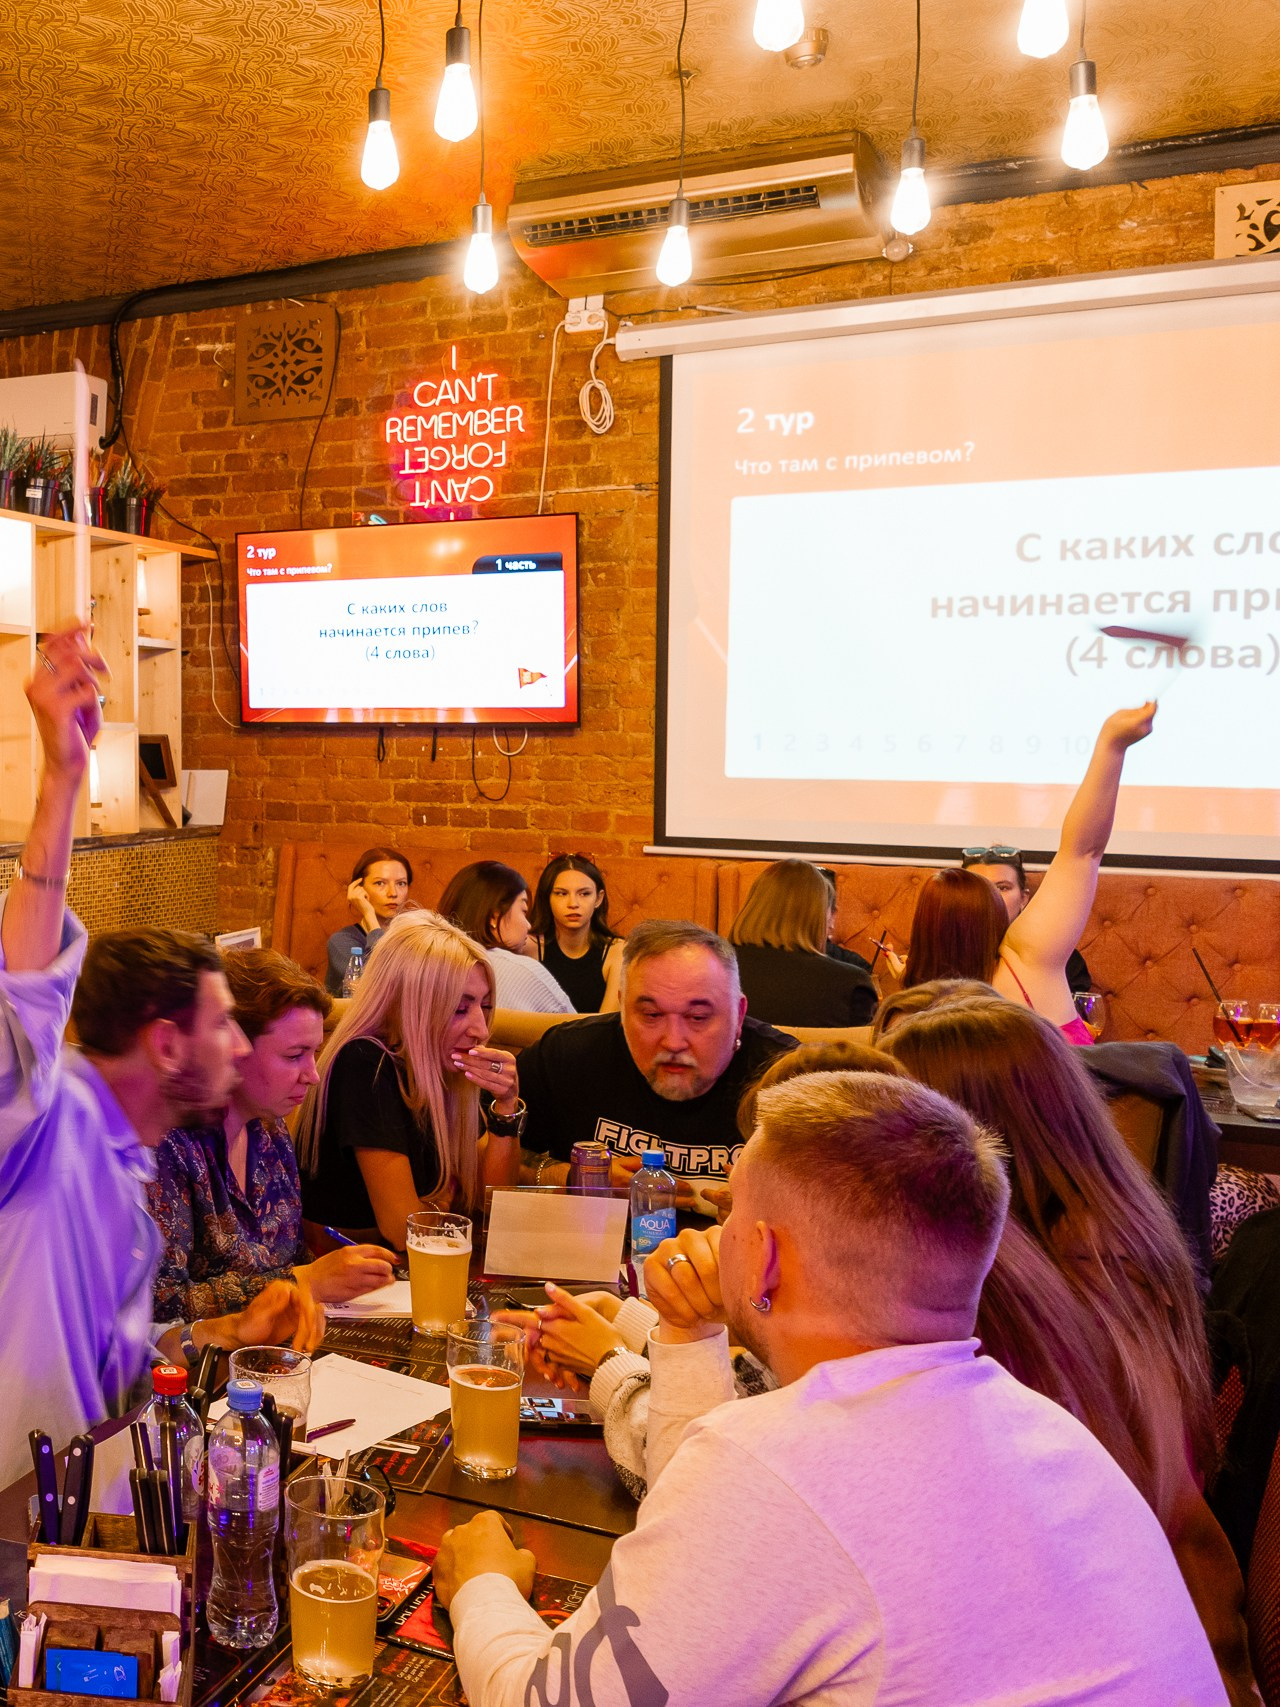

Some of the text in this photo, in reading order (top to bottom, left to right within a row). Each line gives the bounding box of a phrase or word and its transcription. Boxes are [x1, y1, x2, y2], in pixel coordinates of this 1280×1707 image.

[450, 344, 457, 371] I
[412, 372, 499, 408] CAN'T
[384, 404, 526, 444] REMEMBER
[736, 406, 815, 437] 2 тур
[399, 440, 507, 474] FORGET
[734, 442, 976, 477] Что там с припевом?
[409, 475, 494, 508] CAN'T
[246, 545, 277, 560] 2 тур
[1015, 533, 1043, 563] С
[1059, 532, 1195, 561] каких
[246, 562, 333, 577] Что там с припевом?
[495, 559, 537, 571] 1 часть
[346, 602, 448, 616] С каких слов
[929, 586, 1280, 620] начинается пр
[319, 620, 480, 639] начинается припев?
[365, 645, 436, 662] (4 слова)
[1065, 633, 1280, 677] (4 слова)
[753, 734, 1091, 755] 1 2 3 4 5 6 7 8 9 10
[639, 1217, 670, 1232] AQUA
